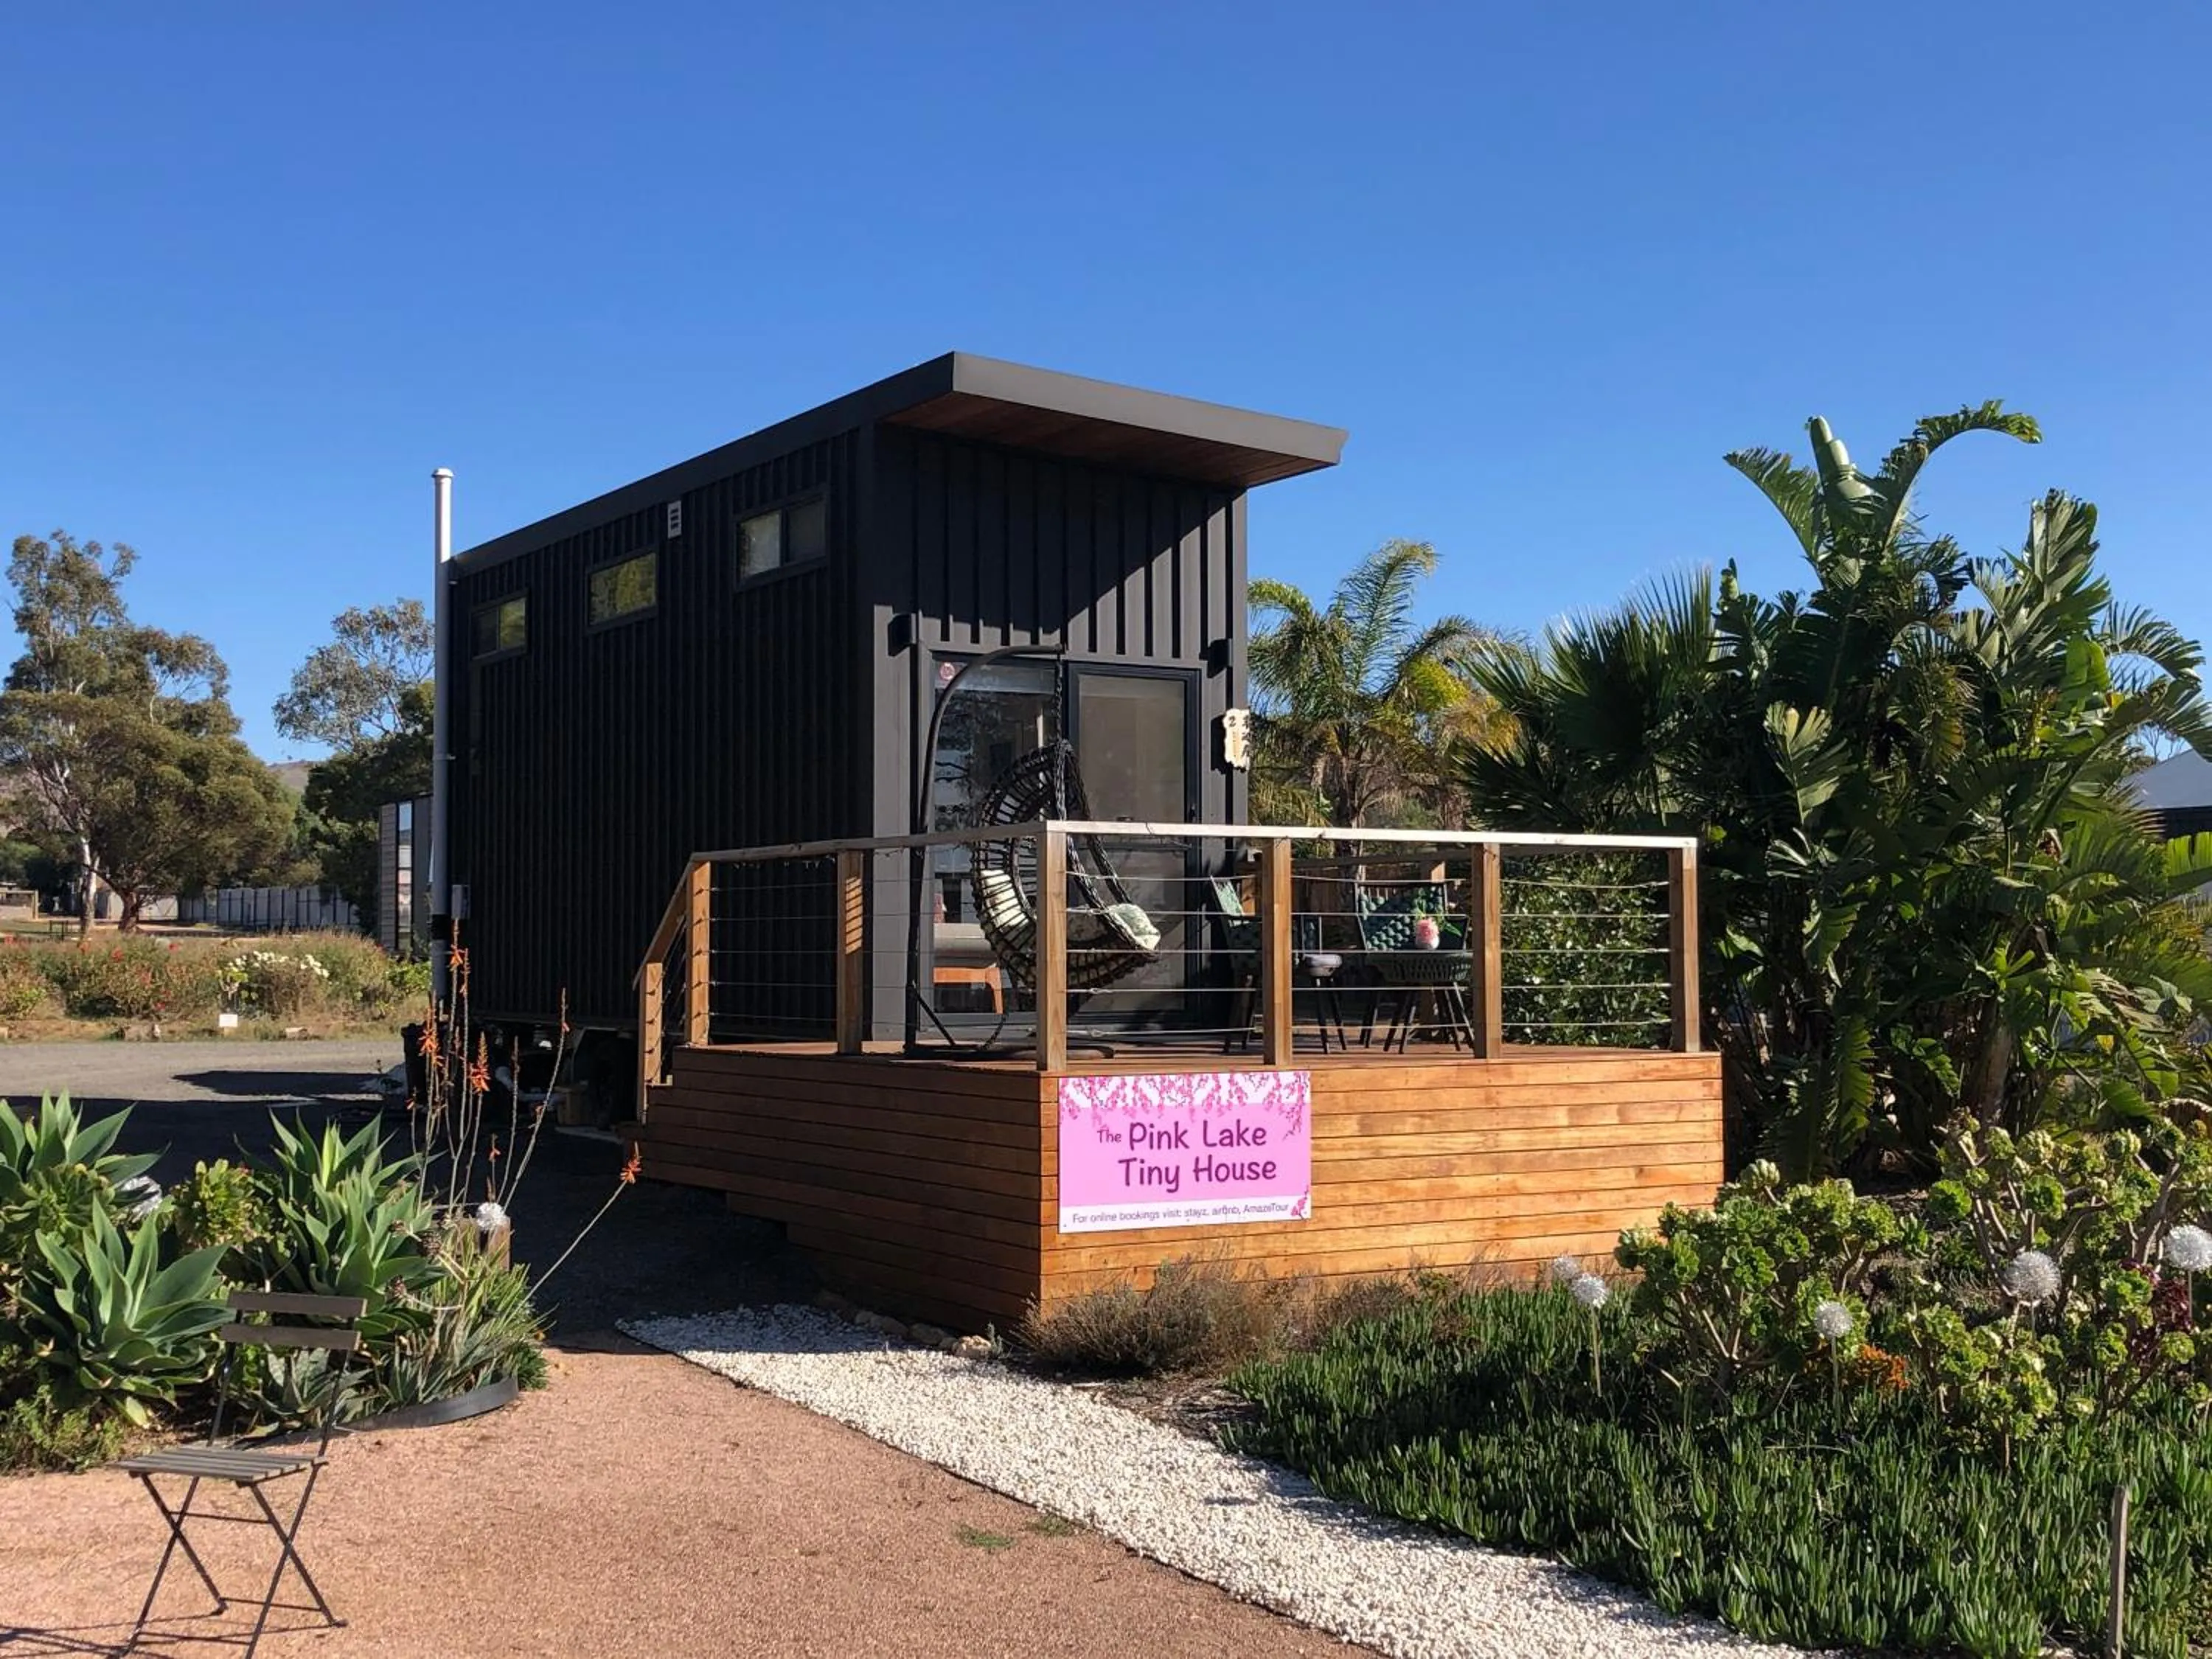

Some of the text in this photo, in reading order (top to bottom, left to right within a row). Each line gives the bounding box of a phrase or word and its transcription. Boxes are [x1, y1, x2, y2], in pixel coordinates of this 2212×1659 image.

[1097, 1119, 1267, 1151] The Pink Lake
[1118, 1154, 1276, 1193] Tiny House
[1073, 1213, 1088, 1223] For
[1090, 1211, 1117, 1222] online
[1119, 1210, 1160, 1222] bookings
